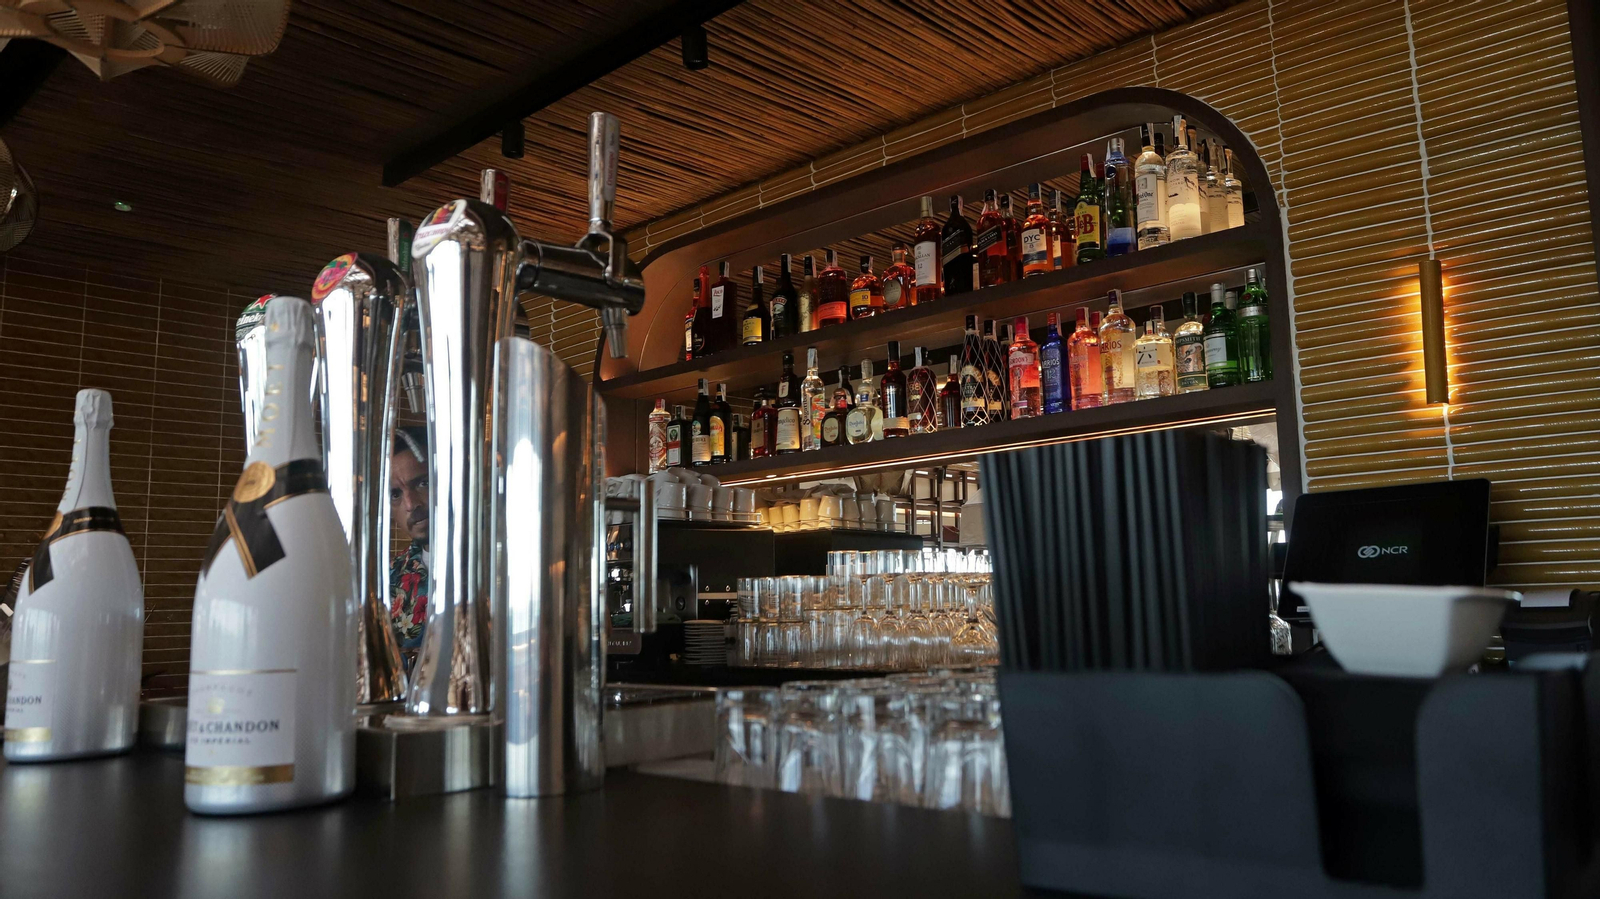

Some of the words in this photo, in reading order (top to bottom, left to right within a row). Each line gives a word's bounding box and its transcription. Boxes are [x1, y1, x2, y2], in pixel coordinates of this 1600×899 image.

[1024, 234, 1041, 244] DYC
[1101, 340, 1122, 353] ARIOS
[1381, 546, 1408, 555] NCR
[206, 720, 280, 734] CHANDON
